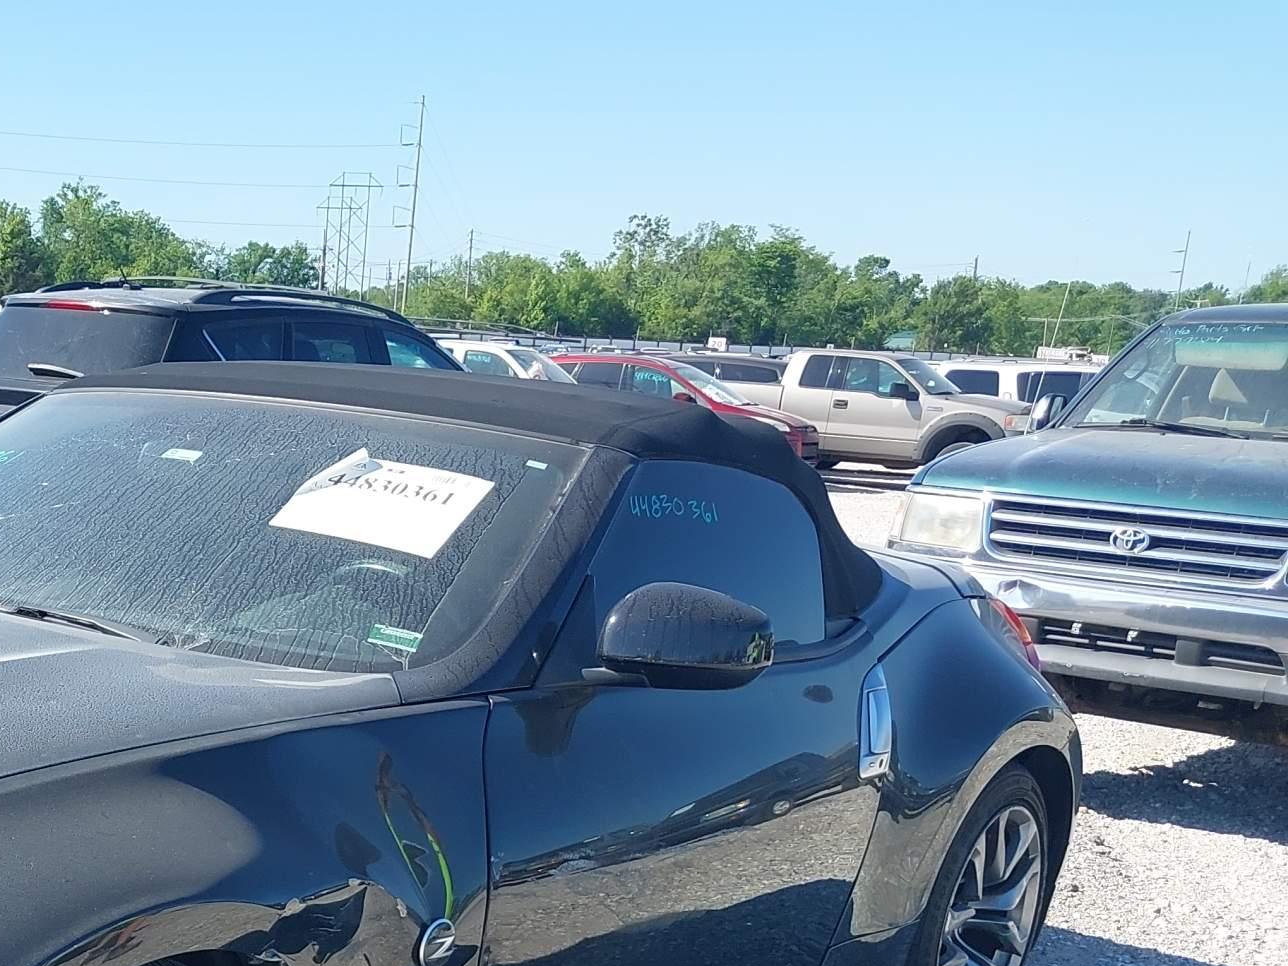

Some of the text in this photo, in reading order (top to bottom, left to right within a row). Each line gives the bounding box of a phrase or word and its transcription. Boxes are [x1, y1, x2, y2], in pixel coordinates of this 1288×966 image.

[327, 473, 455, 505] 44830361
[630, 495, 718, 523] 44830361
[427, 935, 457, 960] Z
